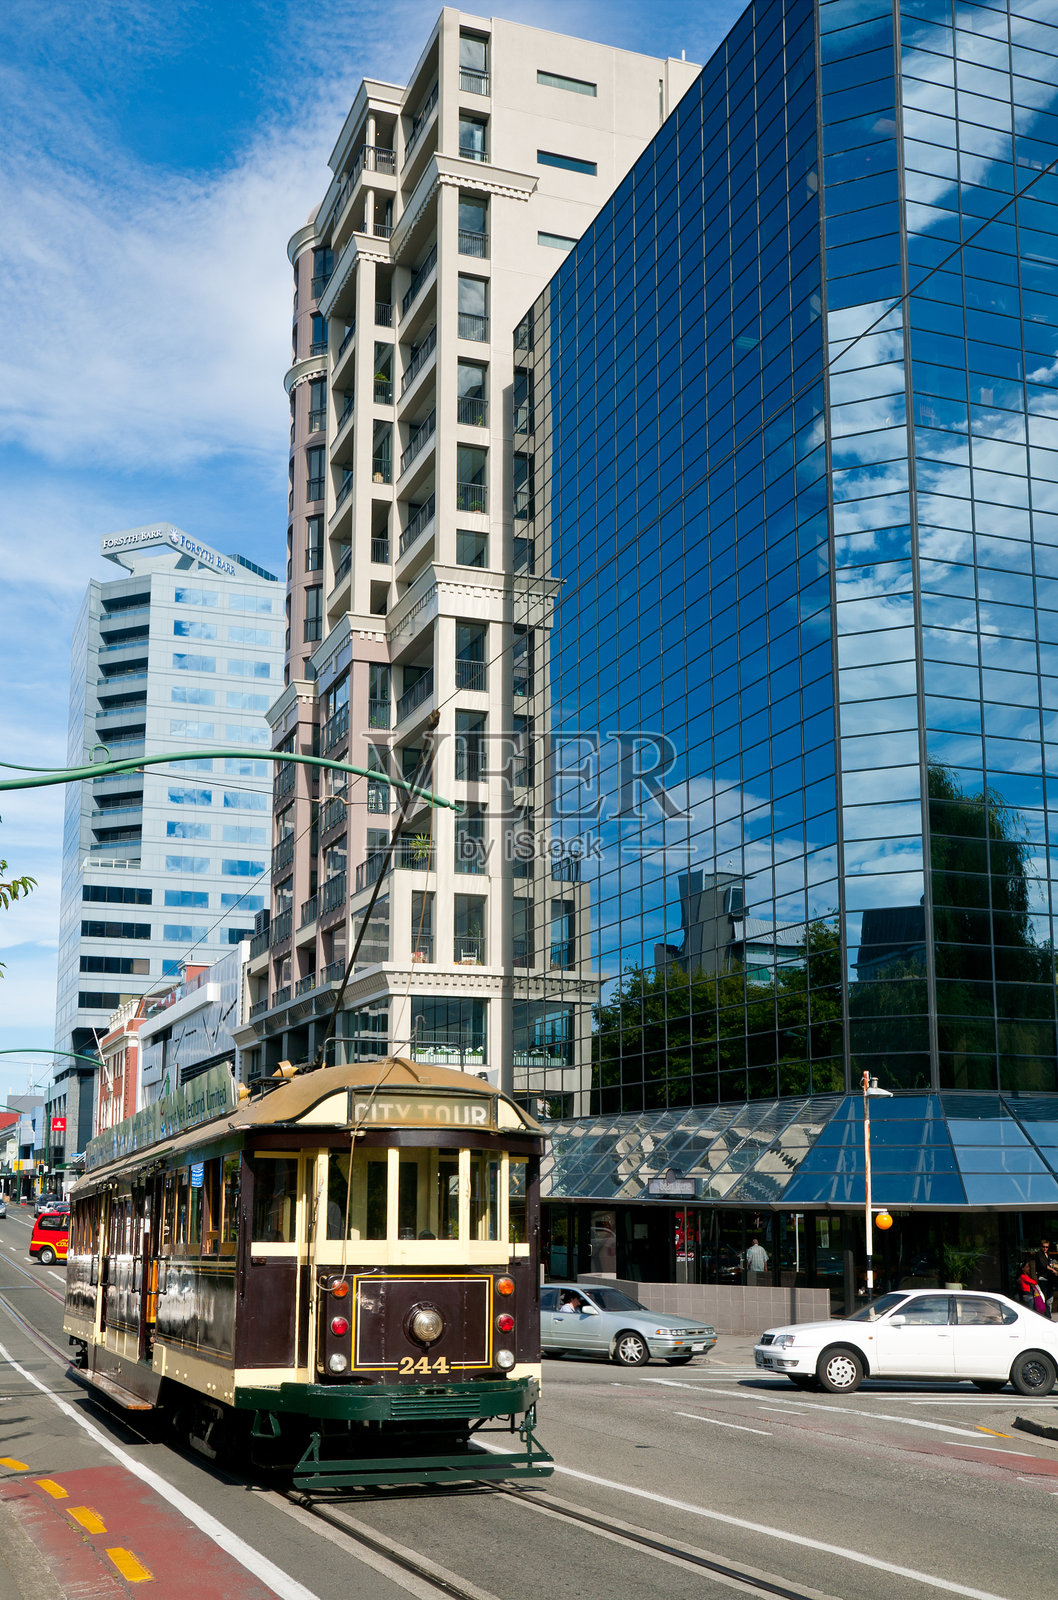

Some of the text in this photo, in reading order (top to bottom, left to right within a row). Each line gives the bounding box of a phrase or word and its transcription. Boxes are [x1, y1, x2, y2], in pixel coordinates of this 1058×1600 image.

[103, 528, 163, 550] FORSYTH BARR
[180, 535, 236, 577] FORSYTH BARR
[354, 1102, 488, 1126] CITY TOUR
[399, 1356, 450, 1375] 244
